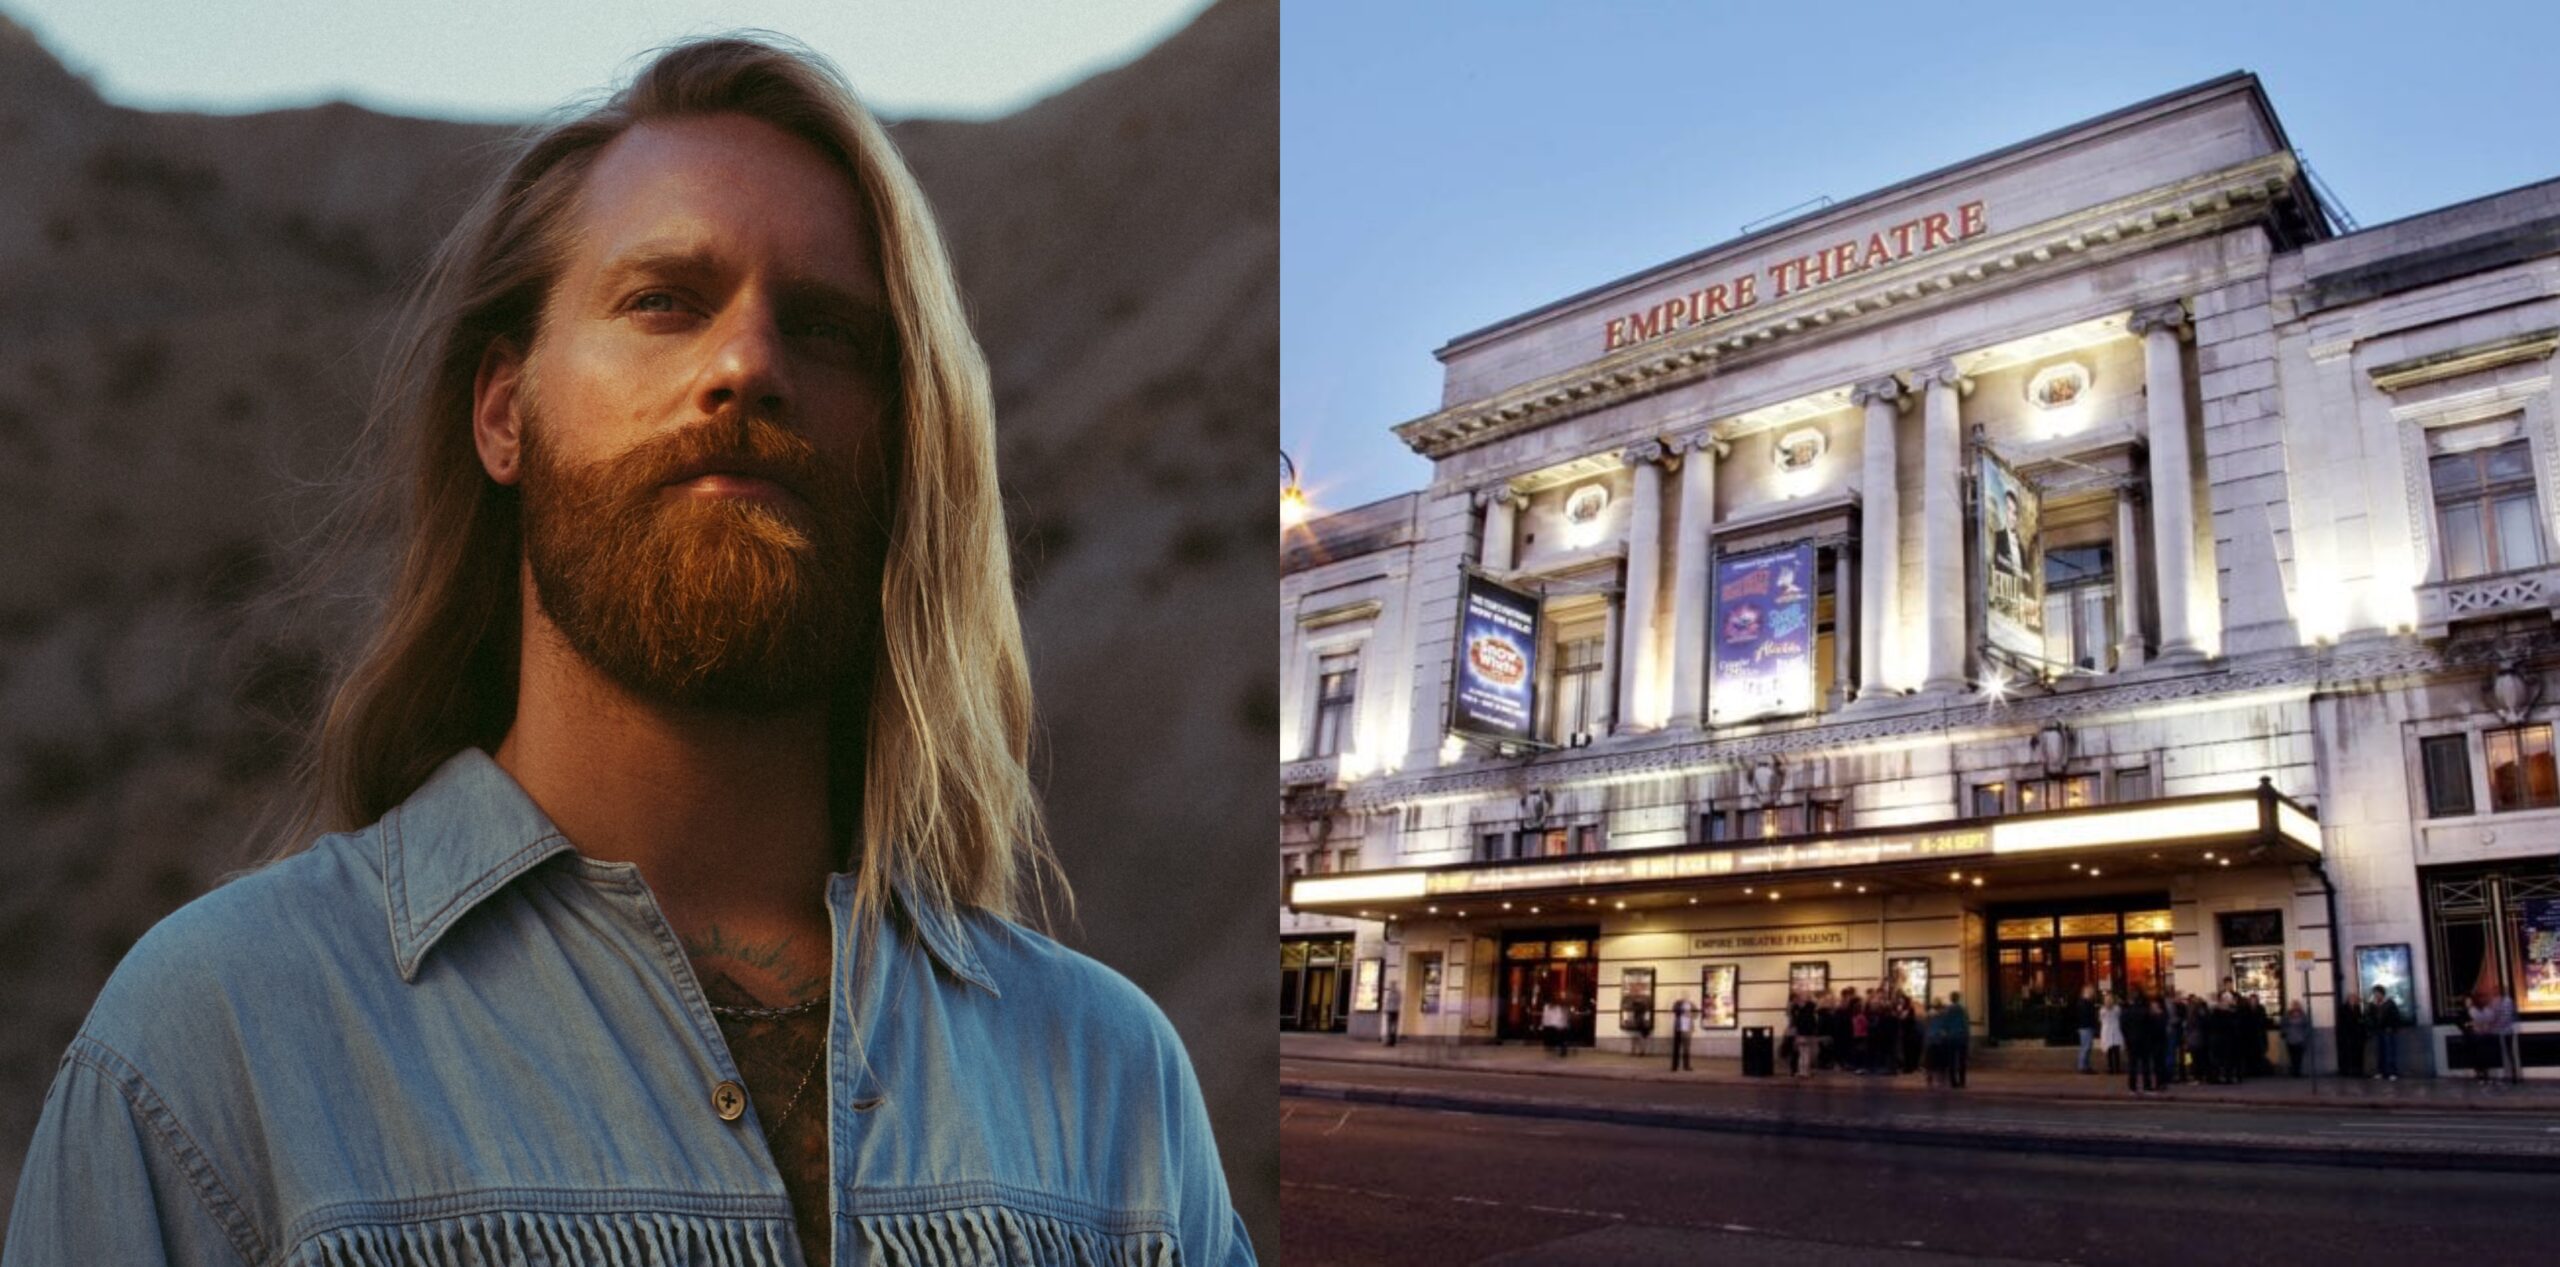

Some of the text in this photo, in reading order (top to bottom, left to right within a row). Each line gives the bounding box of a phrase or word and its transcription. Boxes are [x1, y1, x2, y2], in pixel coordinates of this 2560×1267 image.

[1604, 200, 1988, 352] EMPIRE THEATRE
[1694, 932, 1843, 950] EMPIRE THEATRE PRESENTS
